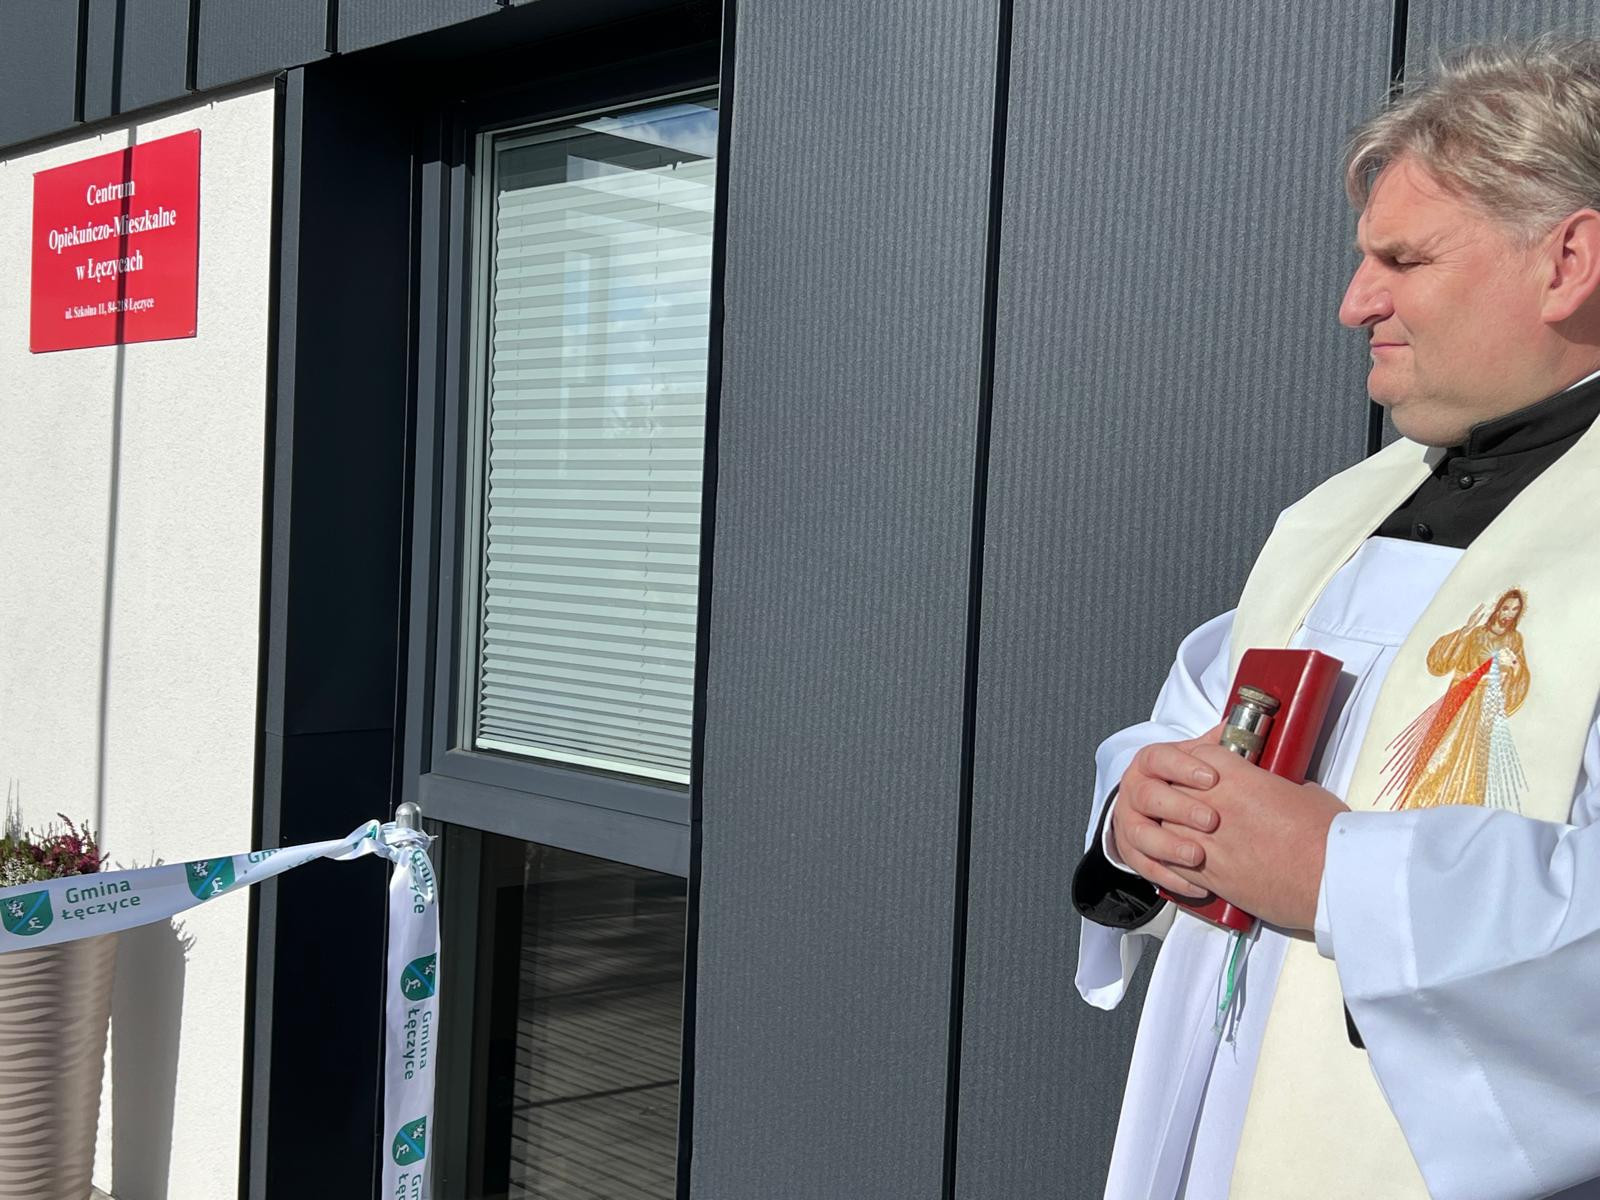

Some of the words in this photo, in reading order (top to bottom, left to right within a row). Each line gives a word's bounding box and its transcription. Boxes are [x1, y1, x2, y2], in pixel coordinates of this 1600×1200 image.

[86, 180, 135, 205] Centrum
[49, 206, 176, 254] Opiekuńczo-Mieszkalne
[76, 264, 84, 280] w
[87, 250, 143, 283] Łęczycach
[65, 307, 73, 319] ul.
[74, 305, 97, 318] Szkolna
[107, 299, 127, 313] 84-218
[129, 298, 155, 313] Łęczyce
[65, 880, 131, 904] Gmina
[61, 895, 141, 920] Łęczyce
[402, 1008, 420, 1080] Łęczyce
[420, 1010, 432, 1070] Gmina
